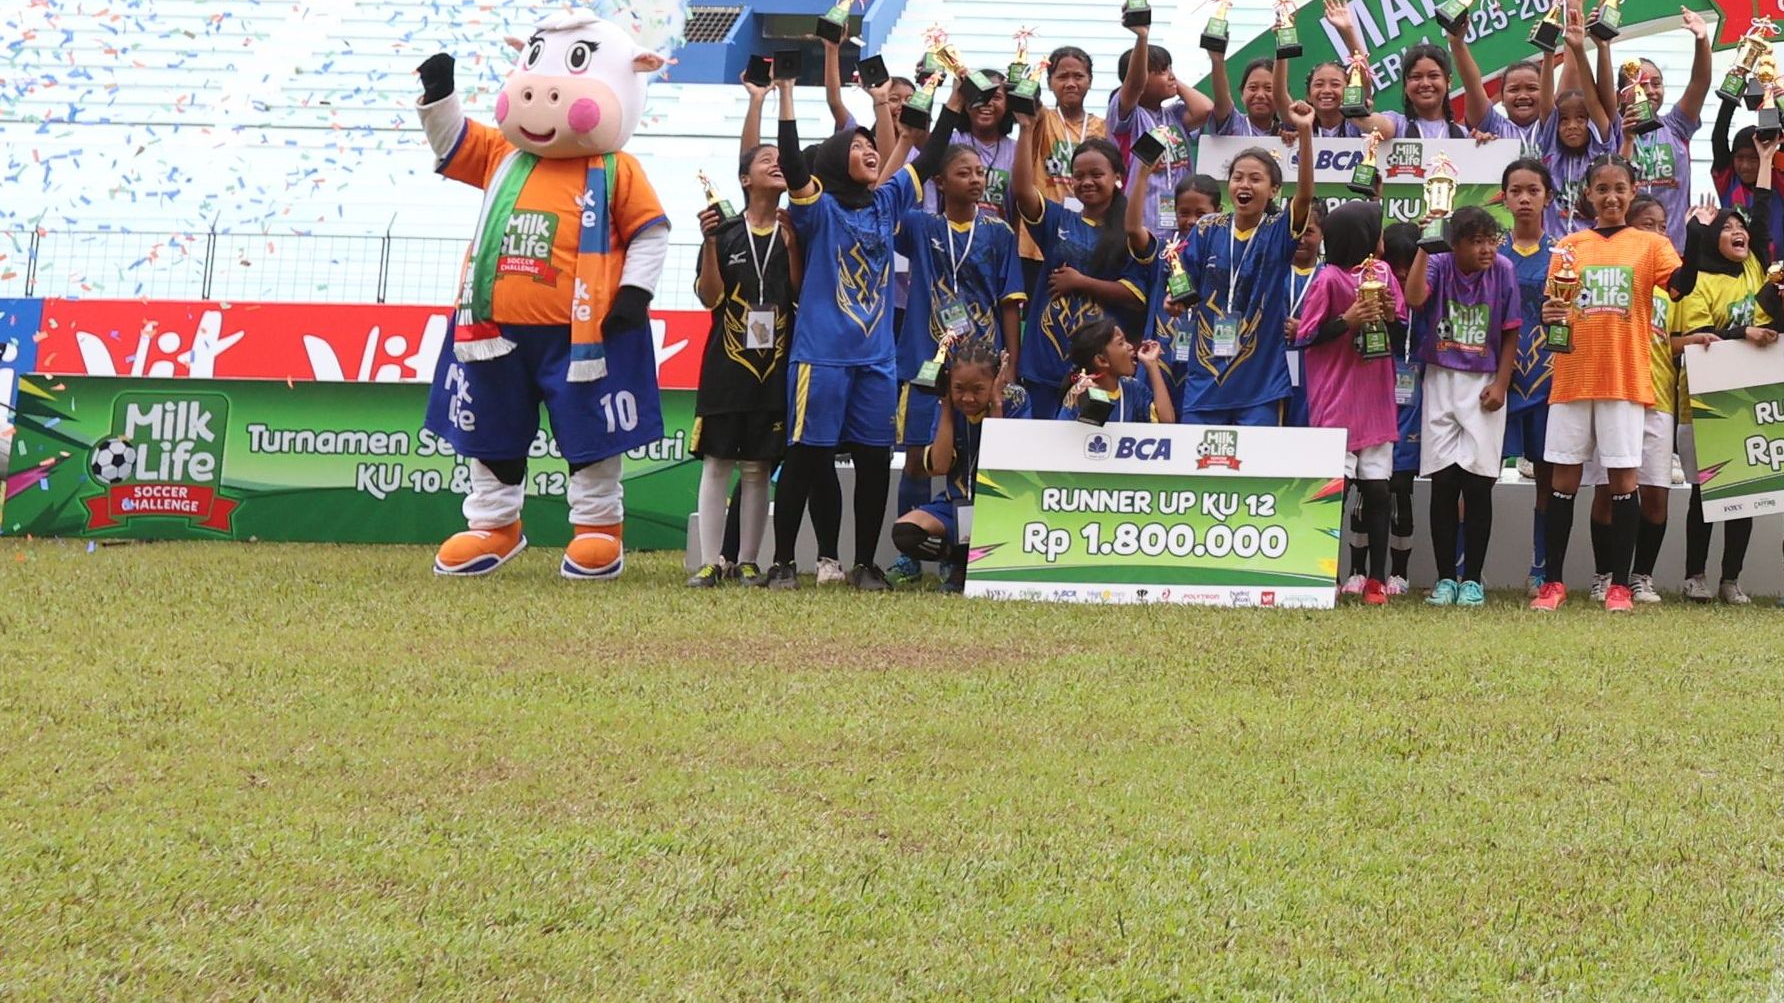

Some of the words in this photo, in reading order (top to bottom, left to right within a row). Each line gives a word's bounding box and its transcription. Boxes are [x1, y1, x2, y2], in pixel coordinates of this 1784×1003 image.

[1315, 149, 1364, 171] BCA
[1395, 143, 1420, 156] Milk
[1399, 154, 1421, 166] Life
[1388, 196, 1422, 222] KU
[507, 212, 550, 237] Milk
[511, 233, 549, 258] Life
[1585, 267, 1629, 288] Milk
[1592, 286, 1629, 306] Life
[1449, 304, 1485, 326] Milk
[1453, 324, 1487, 344] Life
[125, 401, 215, 443] Milk
[600, 390, 639, 434] 10
[246, 424, 410, 456] Turnamen
[1114, 437, 1172, 461] BCA
[1207, 431, 1235, 445] Milk
[1211, 443, 1235, 456] Life
[136, 441, 216, 482] Life
[134, 486, 188, 499] SOCCER
[356, 463, 404, 500] KU
[408, 471, 441, 493] 10
[450, 464, 474, 495] &
[534, 471, 567, 496] 12
[1042, 488, 1151, 515] RUNNER
[1158, 491, 1197, 516] UP
[1202, 492, 1239, 522] KU
[1245, 494, 1276, 517] 12
[1023, 522, 1072, 562] Rp
[1081, 522, 1288, 559] 1.800.000
